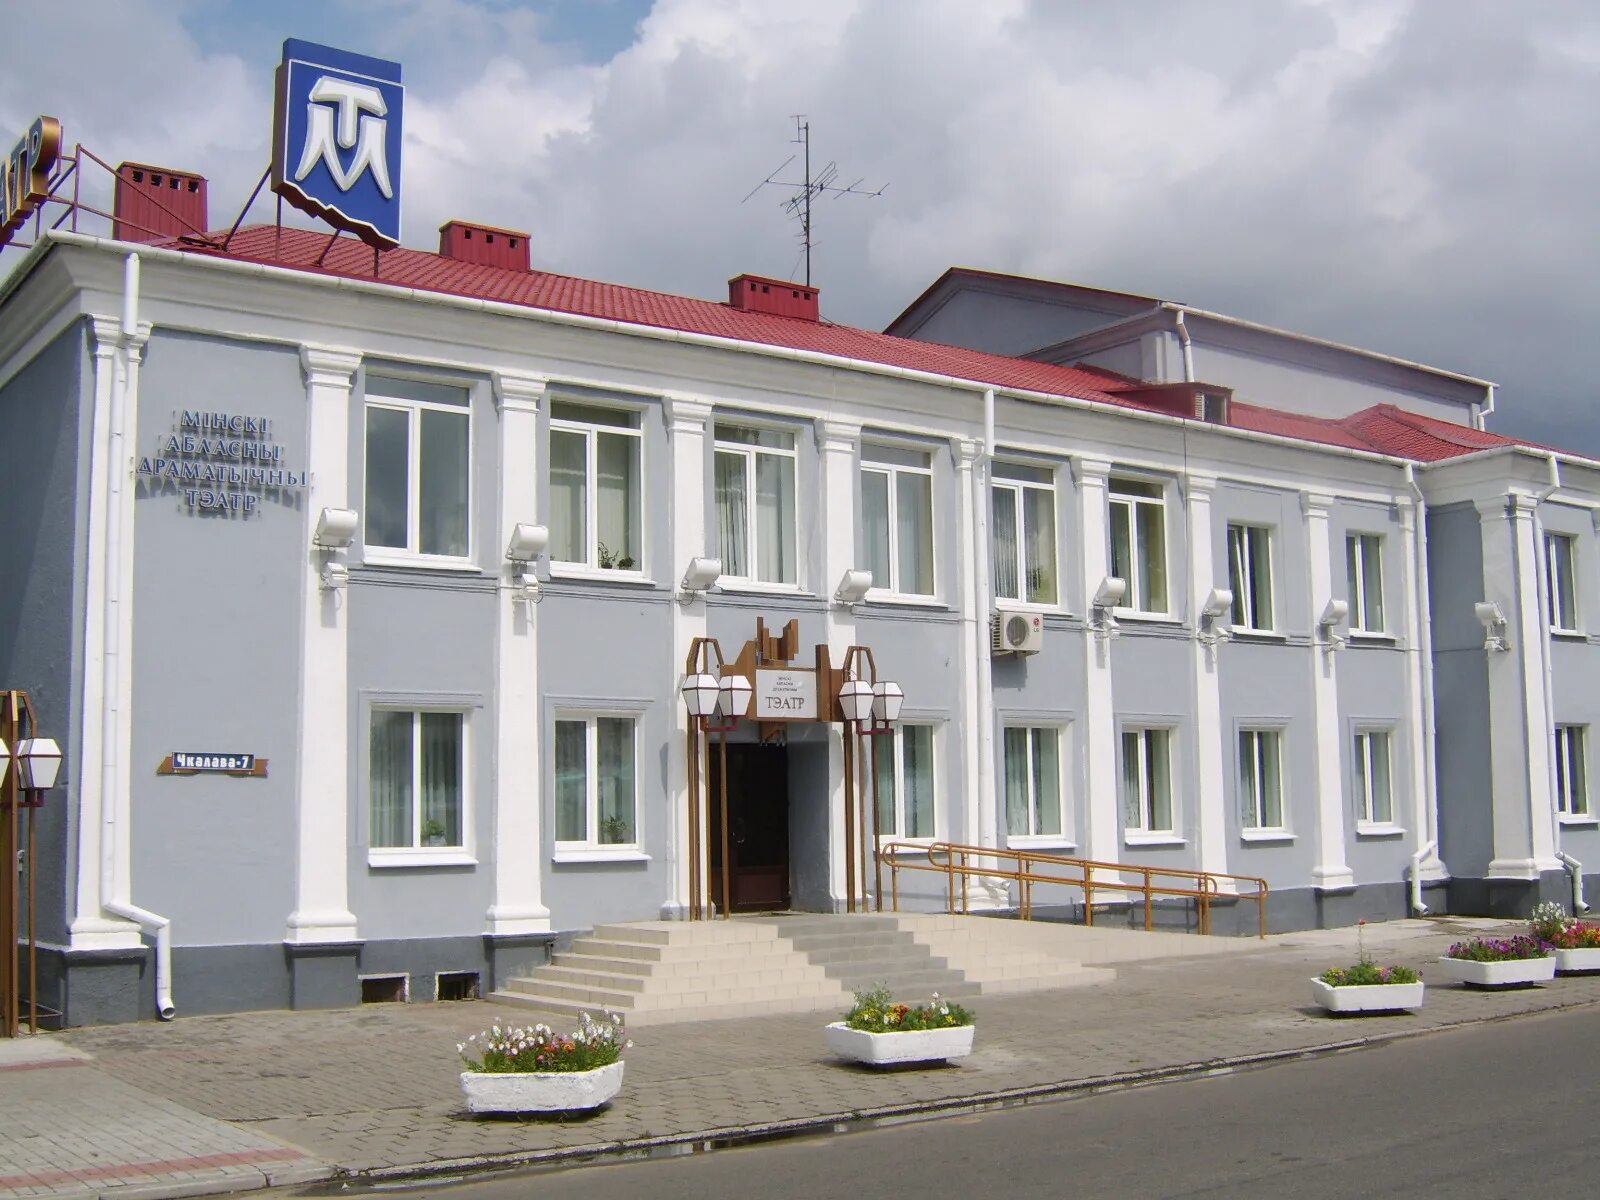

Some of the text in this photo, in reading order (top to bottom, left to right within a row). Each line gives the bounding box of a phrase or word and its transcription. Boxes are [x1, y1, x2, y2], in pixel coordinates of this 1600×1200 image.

[181, 410, 269, 433] МІНСКІ
[166, 435, 281, 461] АБЛАСНЫ
[136, 456, 307, 487] ДРАМАТЫЧНЫ
[186, 489, 257, 511] ТЭАТР
[765, 696, 805, 709] ТЭАТР
